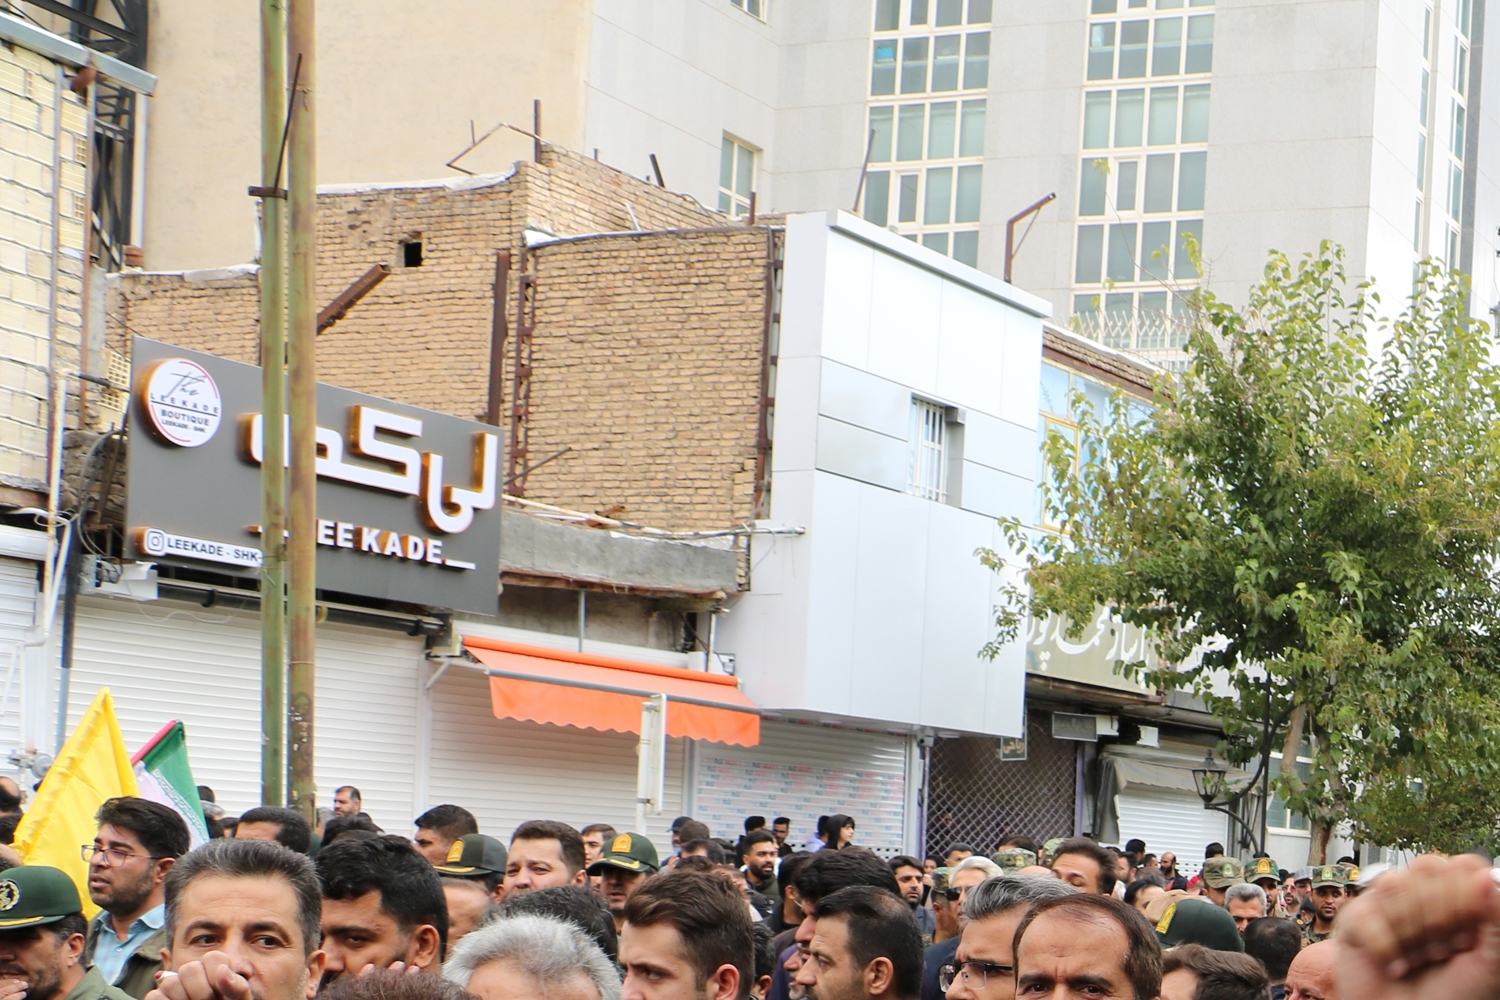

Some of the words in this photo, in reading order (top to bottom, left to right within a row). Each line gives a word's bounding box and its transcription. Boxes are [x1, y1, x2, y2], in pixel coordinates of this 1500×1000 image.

[150, 392, 219, 414] LEEKADE
[161, 409, 210, 426] BOUTIQUE
[168, 537, 224, 556] LEEKADE
[233, 548, 259, 562] SHK
